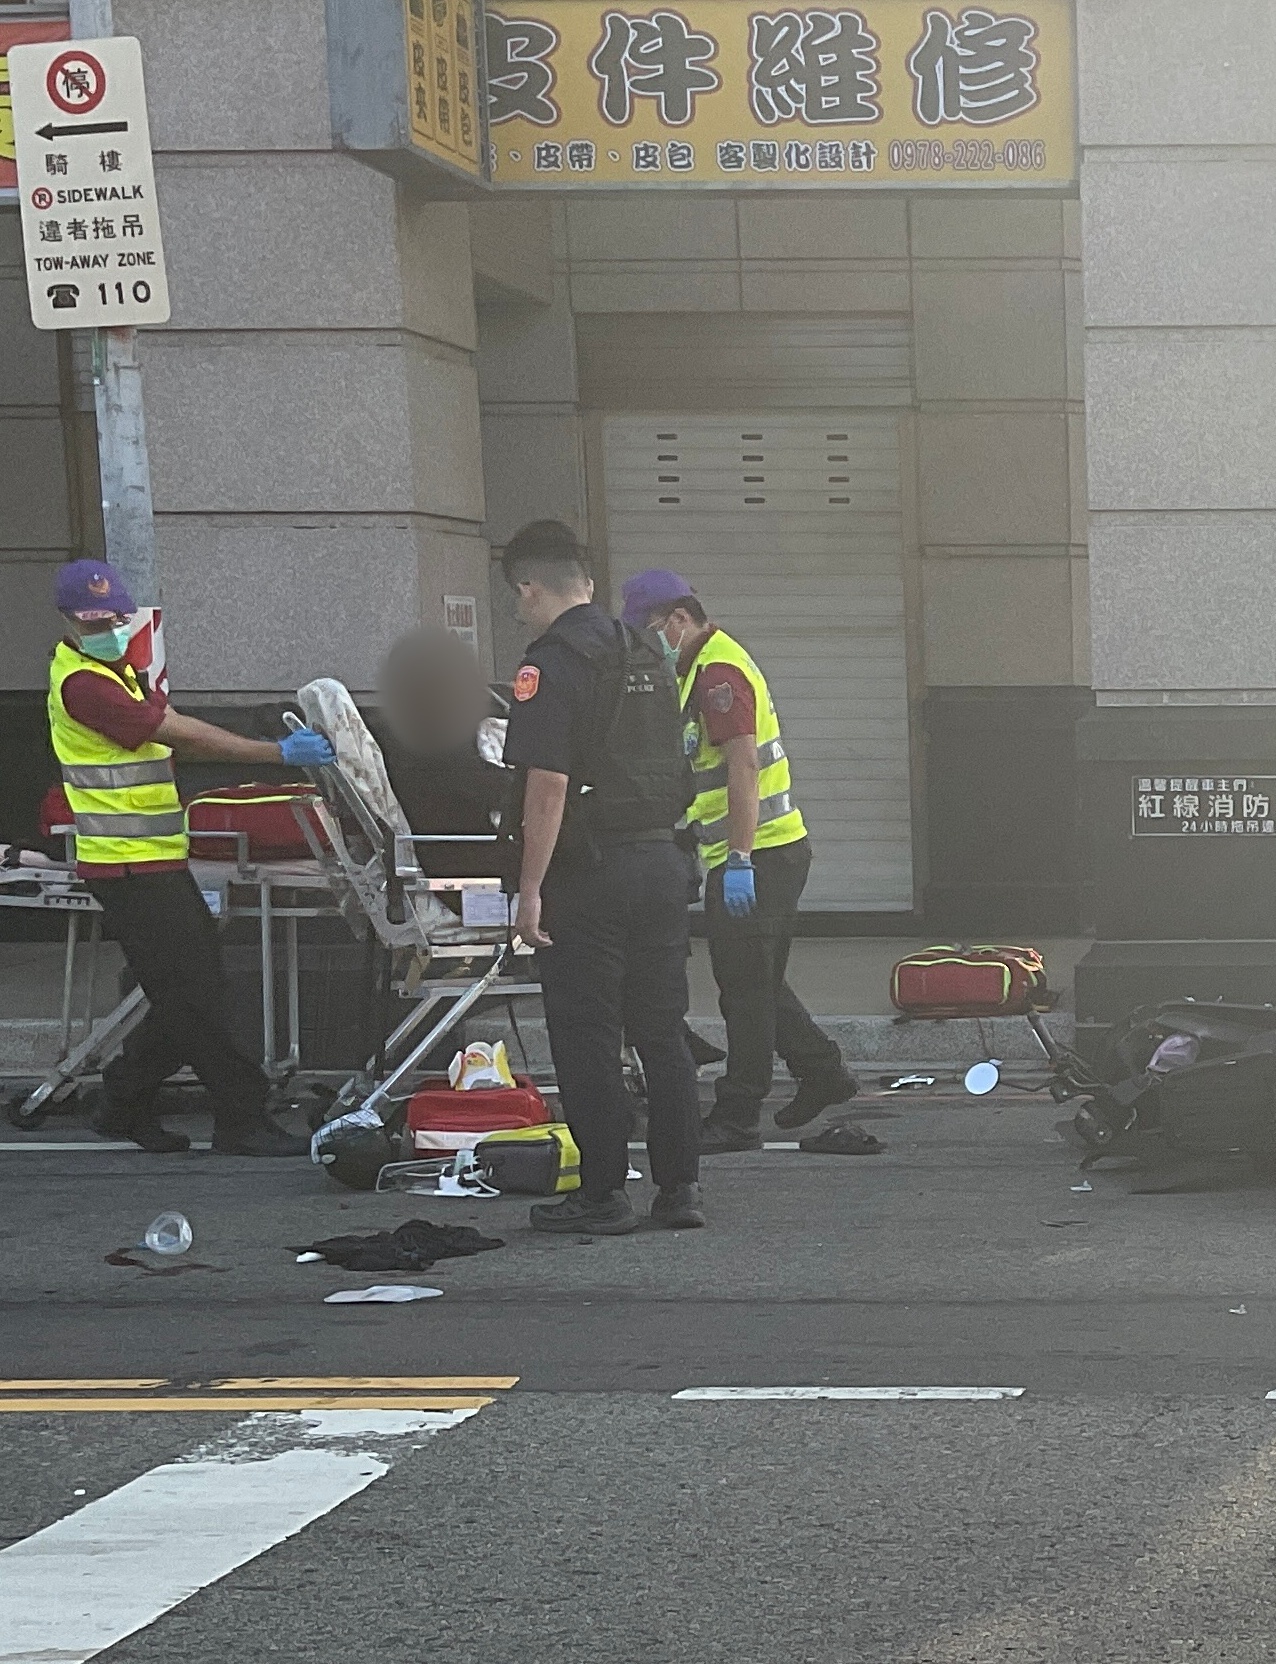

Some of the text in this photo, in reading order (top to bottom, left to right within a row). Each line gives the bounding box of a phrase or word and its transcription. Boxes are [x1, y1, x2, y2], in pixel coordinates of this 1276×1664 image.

[45, 150, 122, 175] 騎樓
[716, 139, 878, 172] 客製化設計
[889, 139, 1046, 172] 0978-222-086
[57, 185, 144, 204] SIDEWALK
[39, 214, 144, 242] 違者拖吊
[34, 251, 156, 272] TOW-AWAY ZONE
[98, 280, 151, 306] 110
